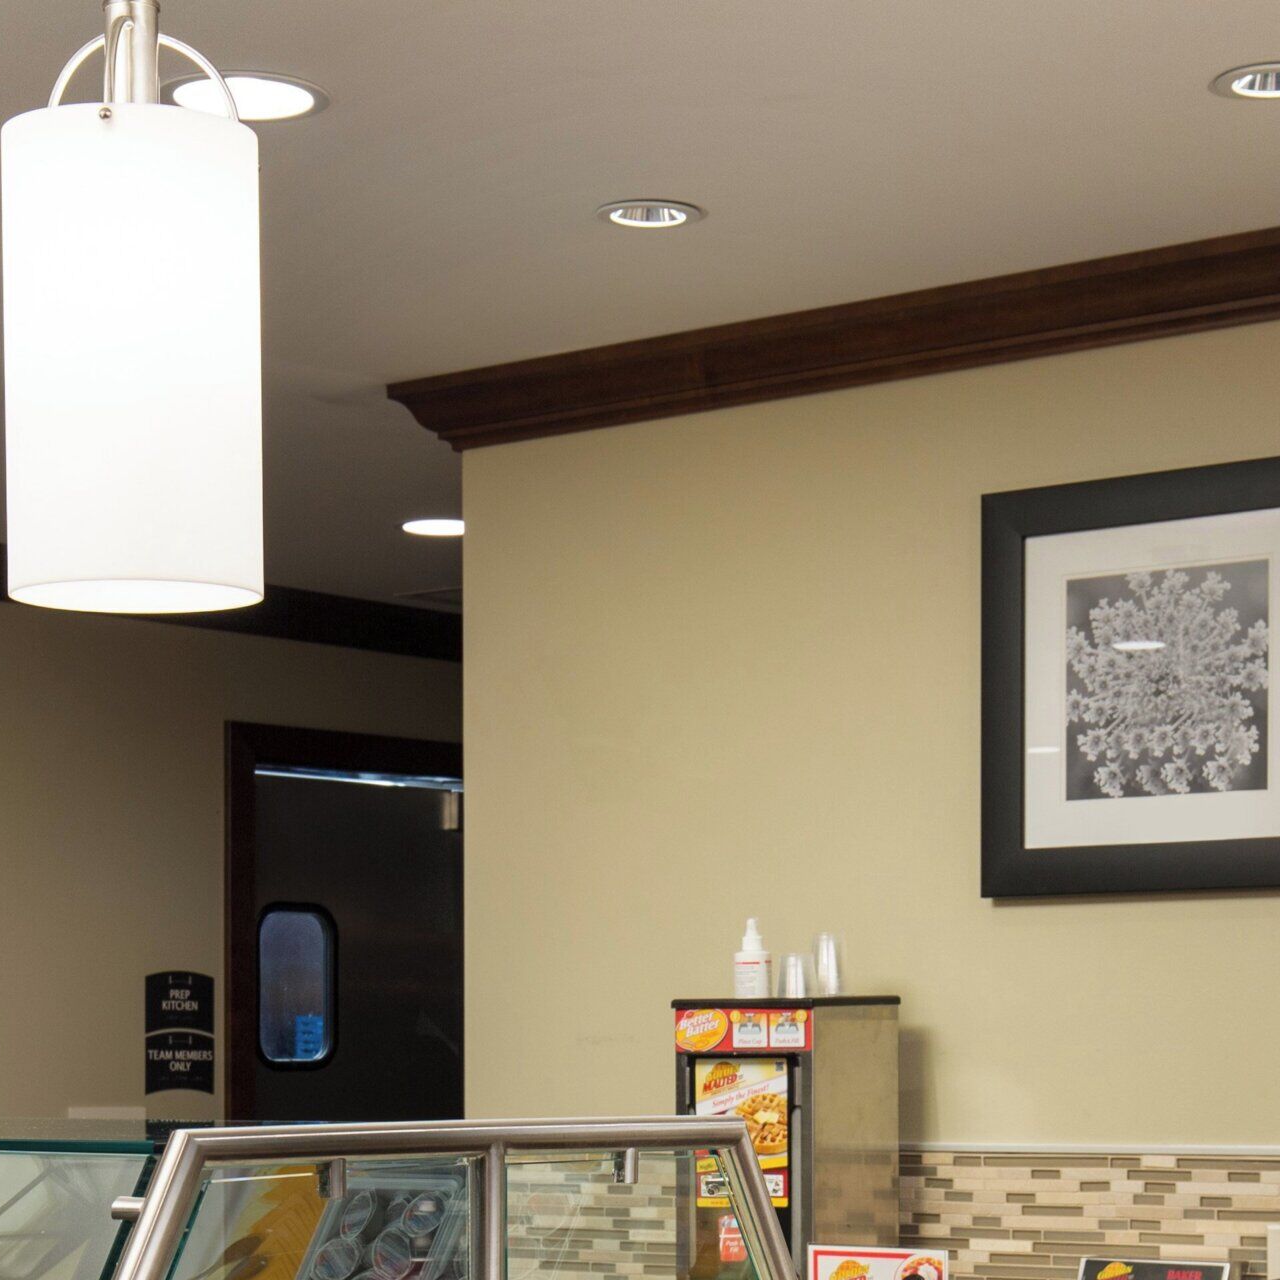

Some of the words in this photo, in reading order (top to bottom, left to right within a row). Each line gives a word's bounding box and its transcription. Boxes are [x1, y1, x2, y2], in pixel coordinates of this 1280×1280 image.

[169, 989, 191, 1000] PREP
[161, 1000, 199, 1011] KITCHEN
[680, 1012, 714, 1029] Better
[148, 1050, 173, 1060] TEAM
[174, 1050, 213, 1061] MEMBERS
[169, 1061, 192, 1072] ONLY
[702, 1074, 738, 1093] MALTED
